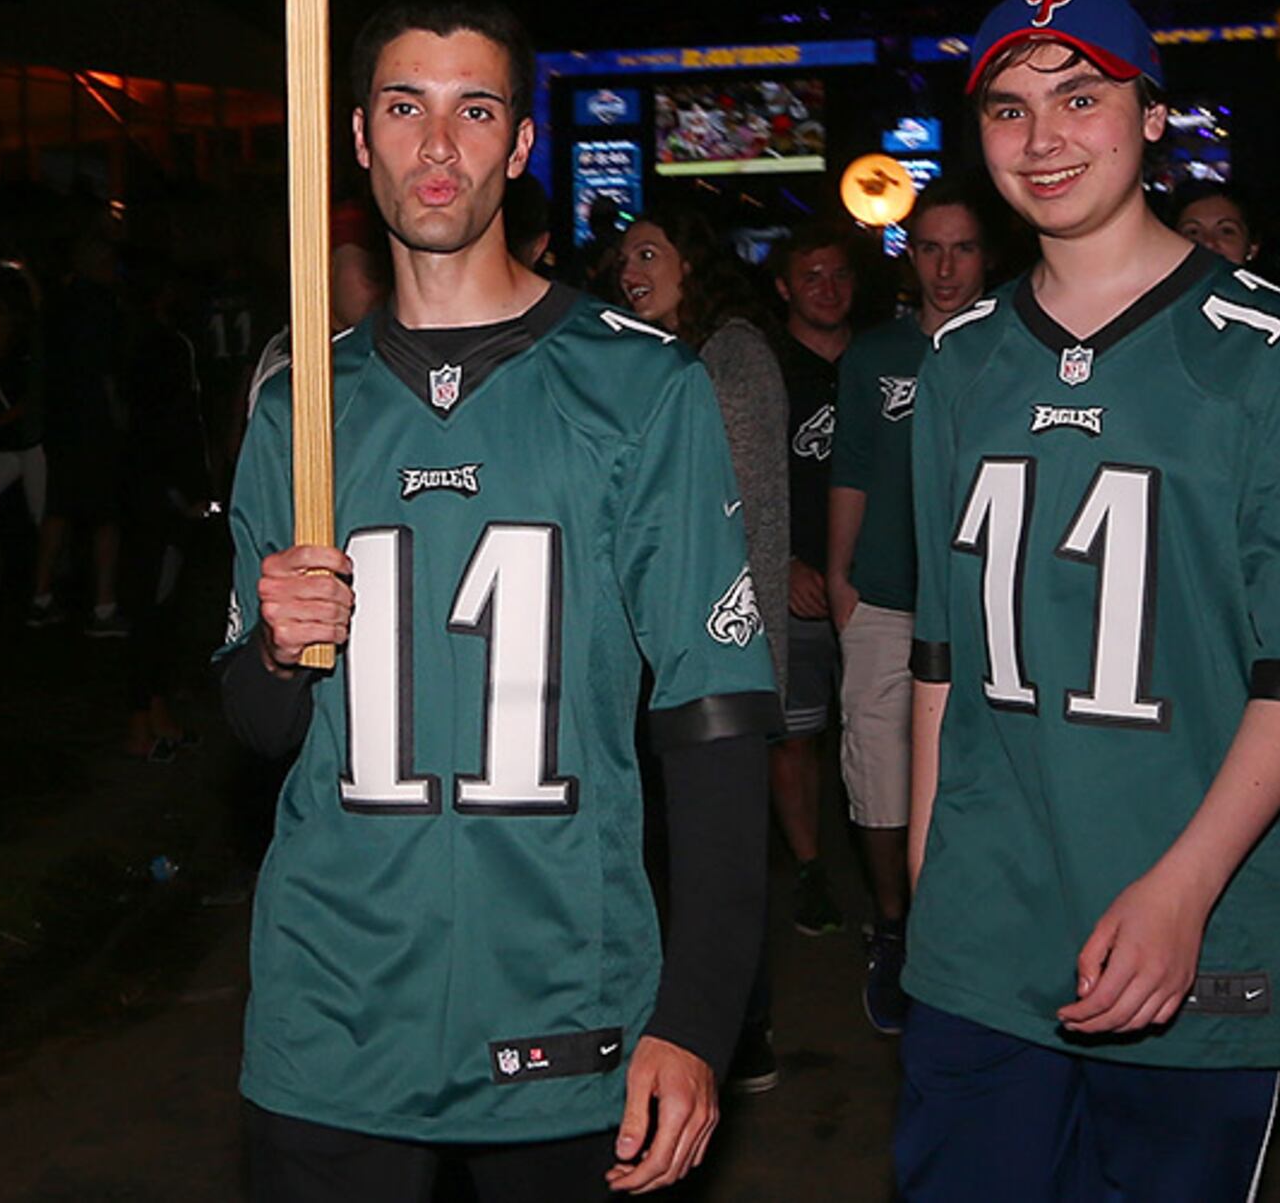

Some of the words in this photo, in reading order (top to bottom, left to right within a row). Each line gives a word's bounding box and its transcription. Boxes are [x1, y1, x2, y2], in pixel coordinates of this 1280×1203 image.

[401, 464, 479, 497] EAGLES
[1030, 405, 1104, 434] EAGLES
[340, 522, 578, 814] 11
[952, 456, 1171, 732] 11
